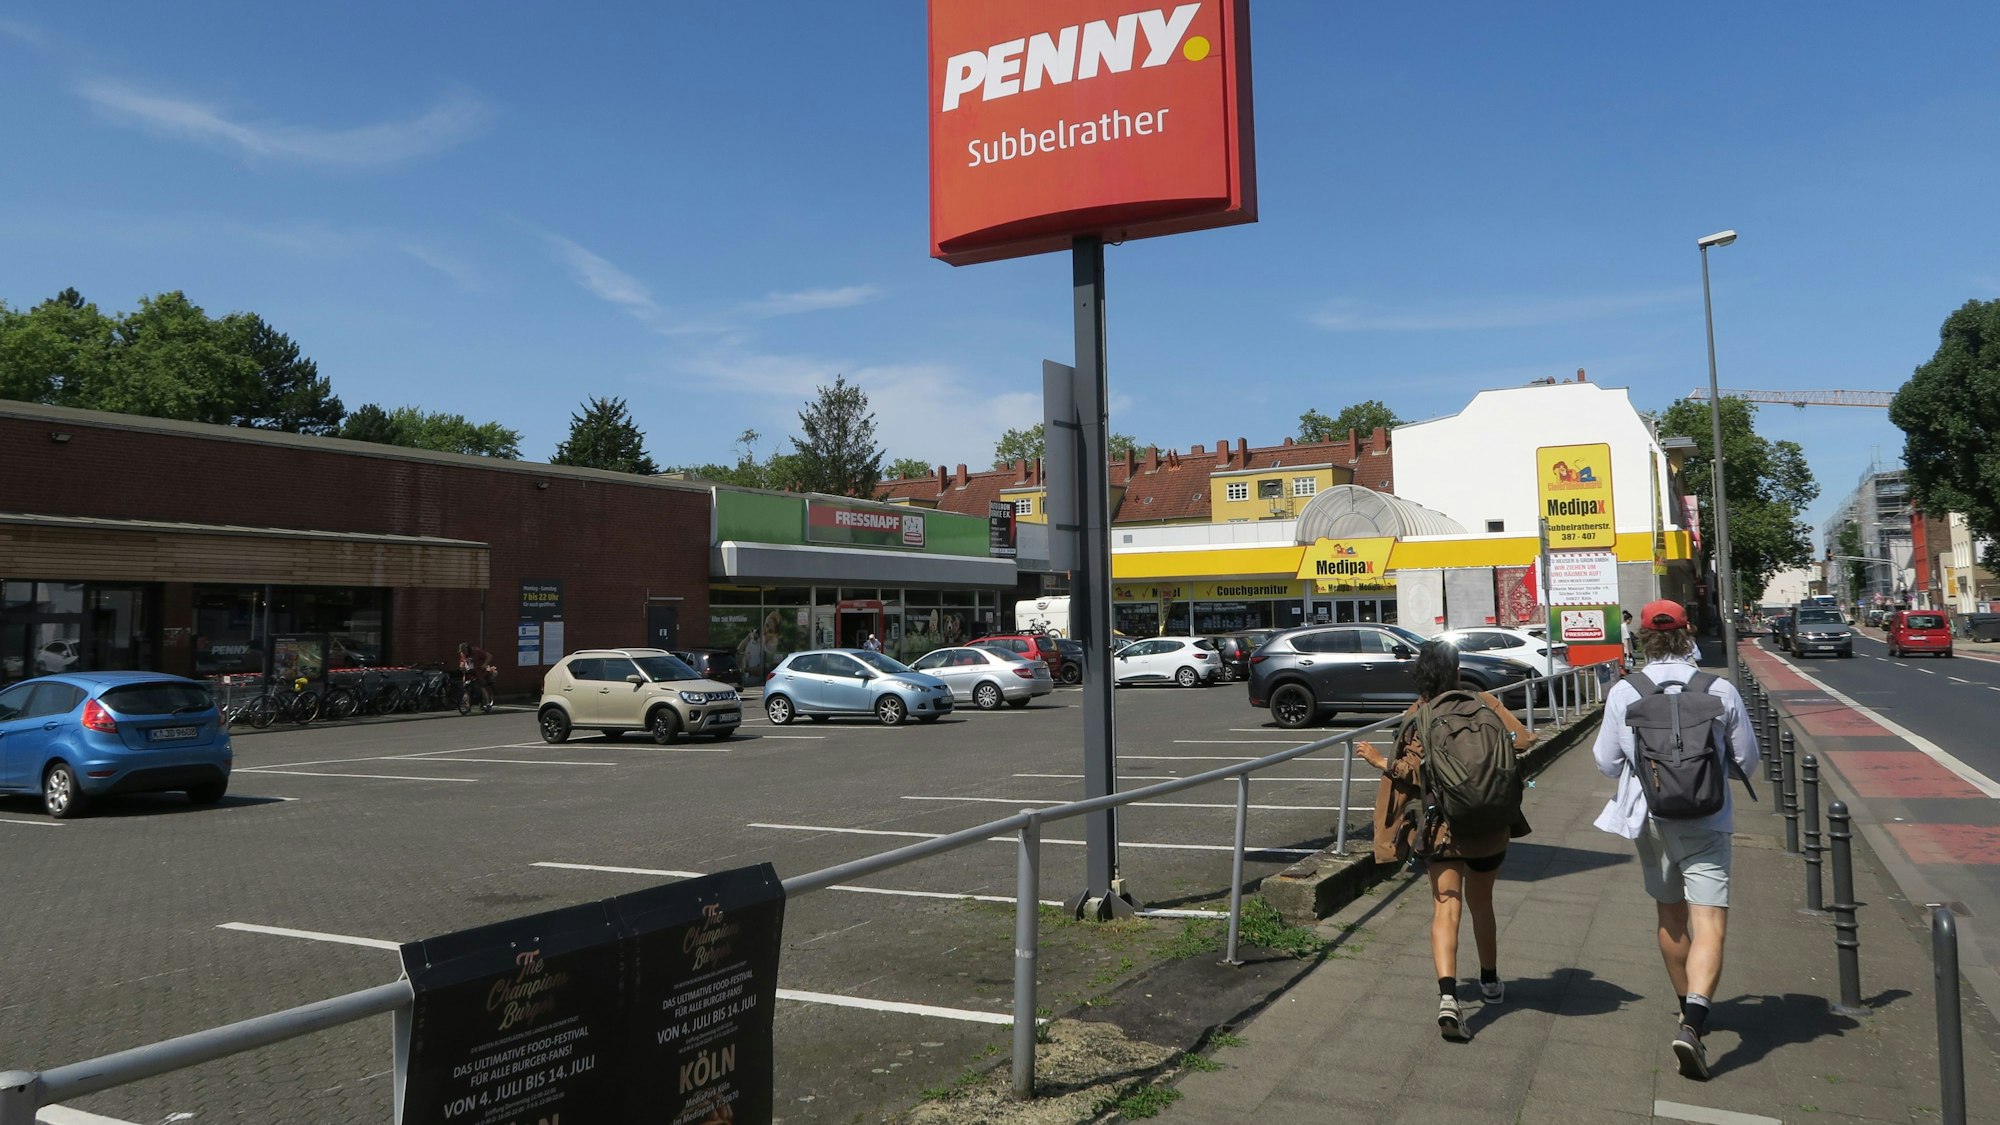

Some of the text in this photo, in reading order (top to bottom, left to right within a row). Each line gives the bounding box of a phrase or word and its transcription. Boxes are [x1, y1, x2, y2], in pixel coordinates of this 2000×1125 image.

[968, 108, 1169, 167] Subbelrather
[835, 511, 900, 529] FRESSNAPF
[1548, 499, 1605, 516] Medipax
[1316, 560, 1374, 575] Medipax
[528, 593, 538, 601] bis
[538, 593, 548, 601] 22
[548, 593, 560, 601] Uhr
[1217, 585, 1288, 596] Couchgarnitur
[702, 903, 724, 930] The
[516, 949, 545, 983] The
[662, 998, 677, 1011] DAS
[677, 984, 713, 1005] ULTIMATIVE
[713, 969, 753, 993] FOOD-FESTIVAL
[675, 985, 743, 1018] FÜR ALLE BURGER-FANS!
[657, 1024, 680, 1044] VON
[681, 1021, 690, 1034] 4.
[692, 1013, 711, 1032] JULI
[712, 1008, 726, 1022] BIS
[728, 1004, 740, 1018] 14.
[741, 993, 757, 1013] JULI
[453, 1026, 589, 1079] DAS ULTIMATIVE FOOD-FESTIVAL
[471, 1043, 573, 1087] FÜR ALLE BURGER-FANS!
[679, 1043, 736, 1095] KÖLN
[444, 1095, 476, 1119] VON
[479, 1090, 492, 1106] 4.
[495, 1079, 522, 1102] JULI
[525, 1071, 546, 1092] BIS
[548, 1066, 568, 1084] 14.
[569, 1054, 596, 1076] JULI
[685, 1089, 717, 1108] MediaPark
[683, 1103, 716, 1124] Mediapark
